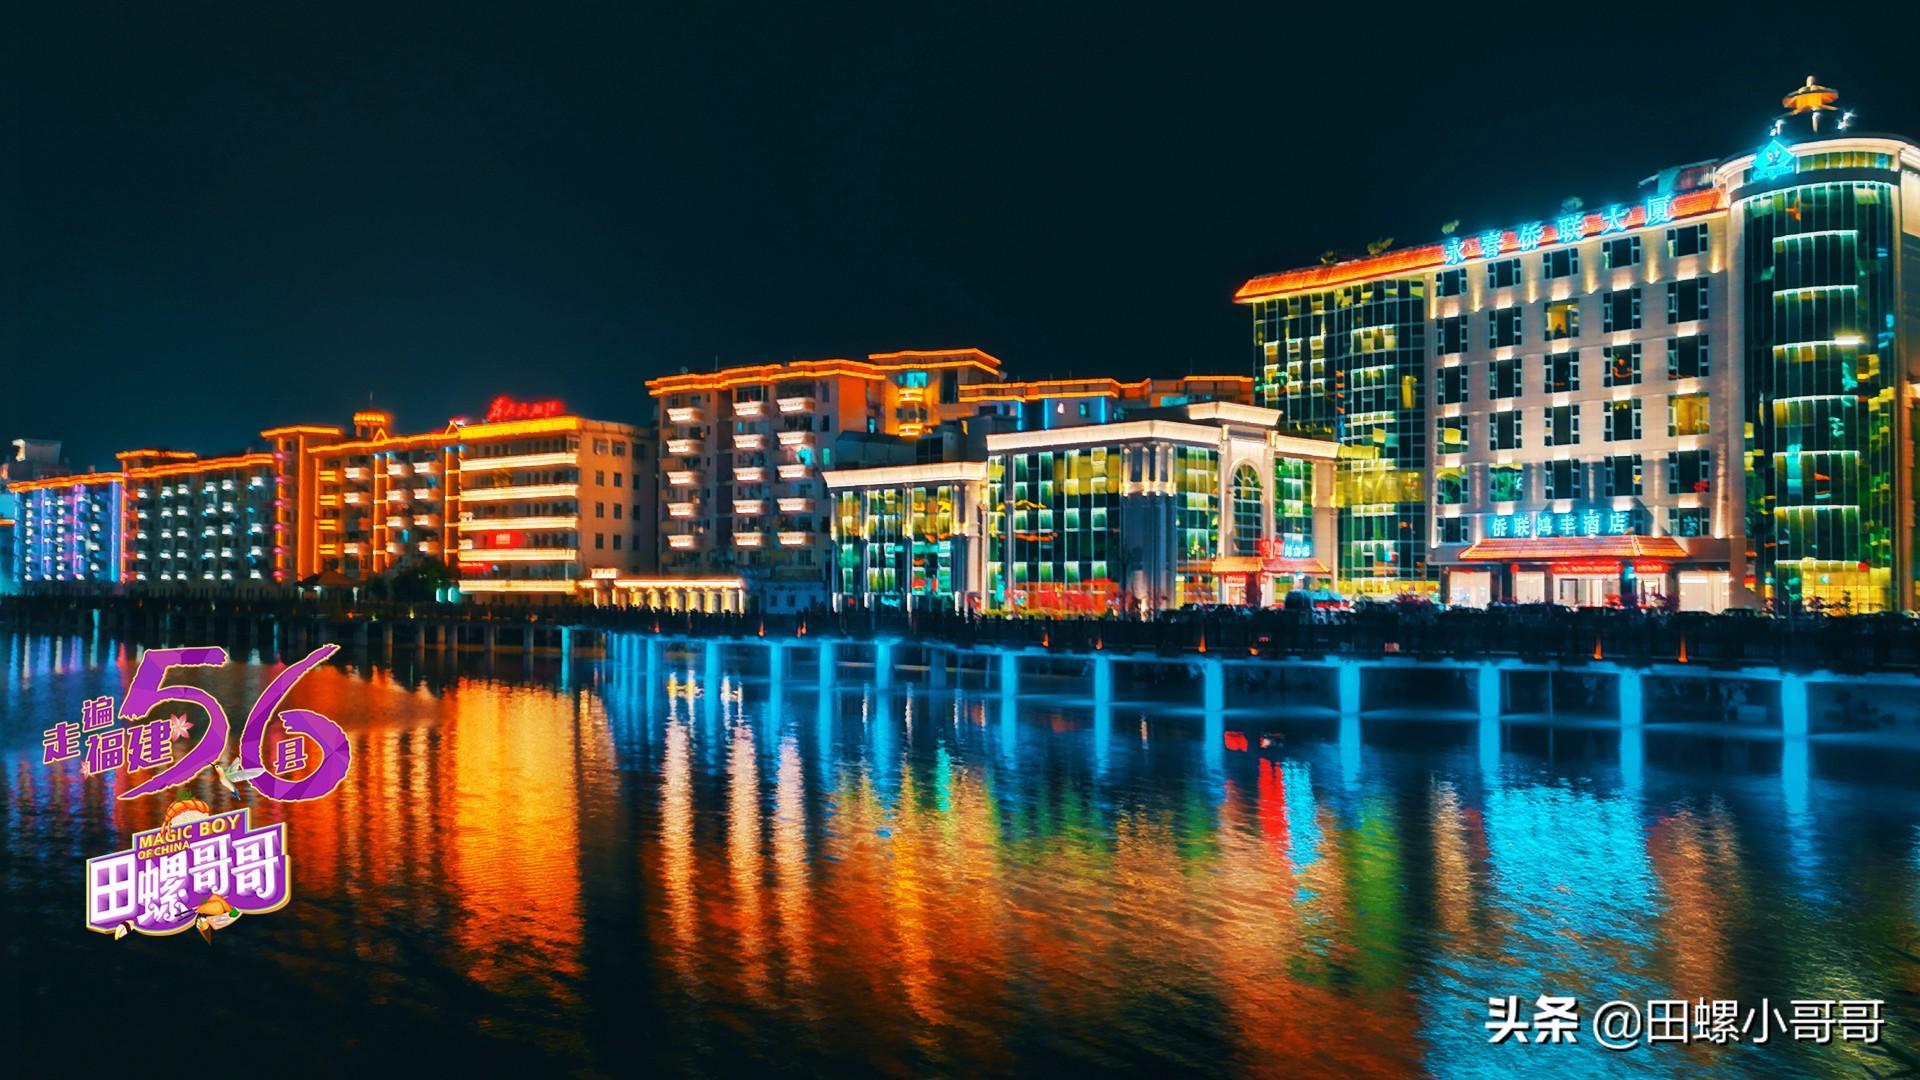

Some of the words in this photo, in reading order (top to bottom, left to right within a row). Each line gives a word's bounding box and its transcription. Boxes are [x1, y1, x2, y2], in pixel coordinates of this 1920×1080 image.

[1446, 193, 1673, 264] 永春侨联大厦
[1492, 510, 1626, 536] 侨联鸿丰酒店
